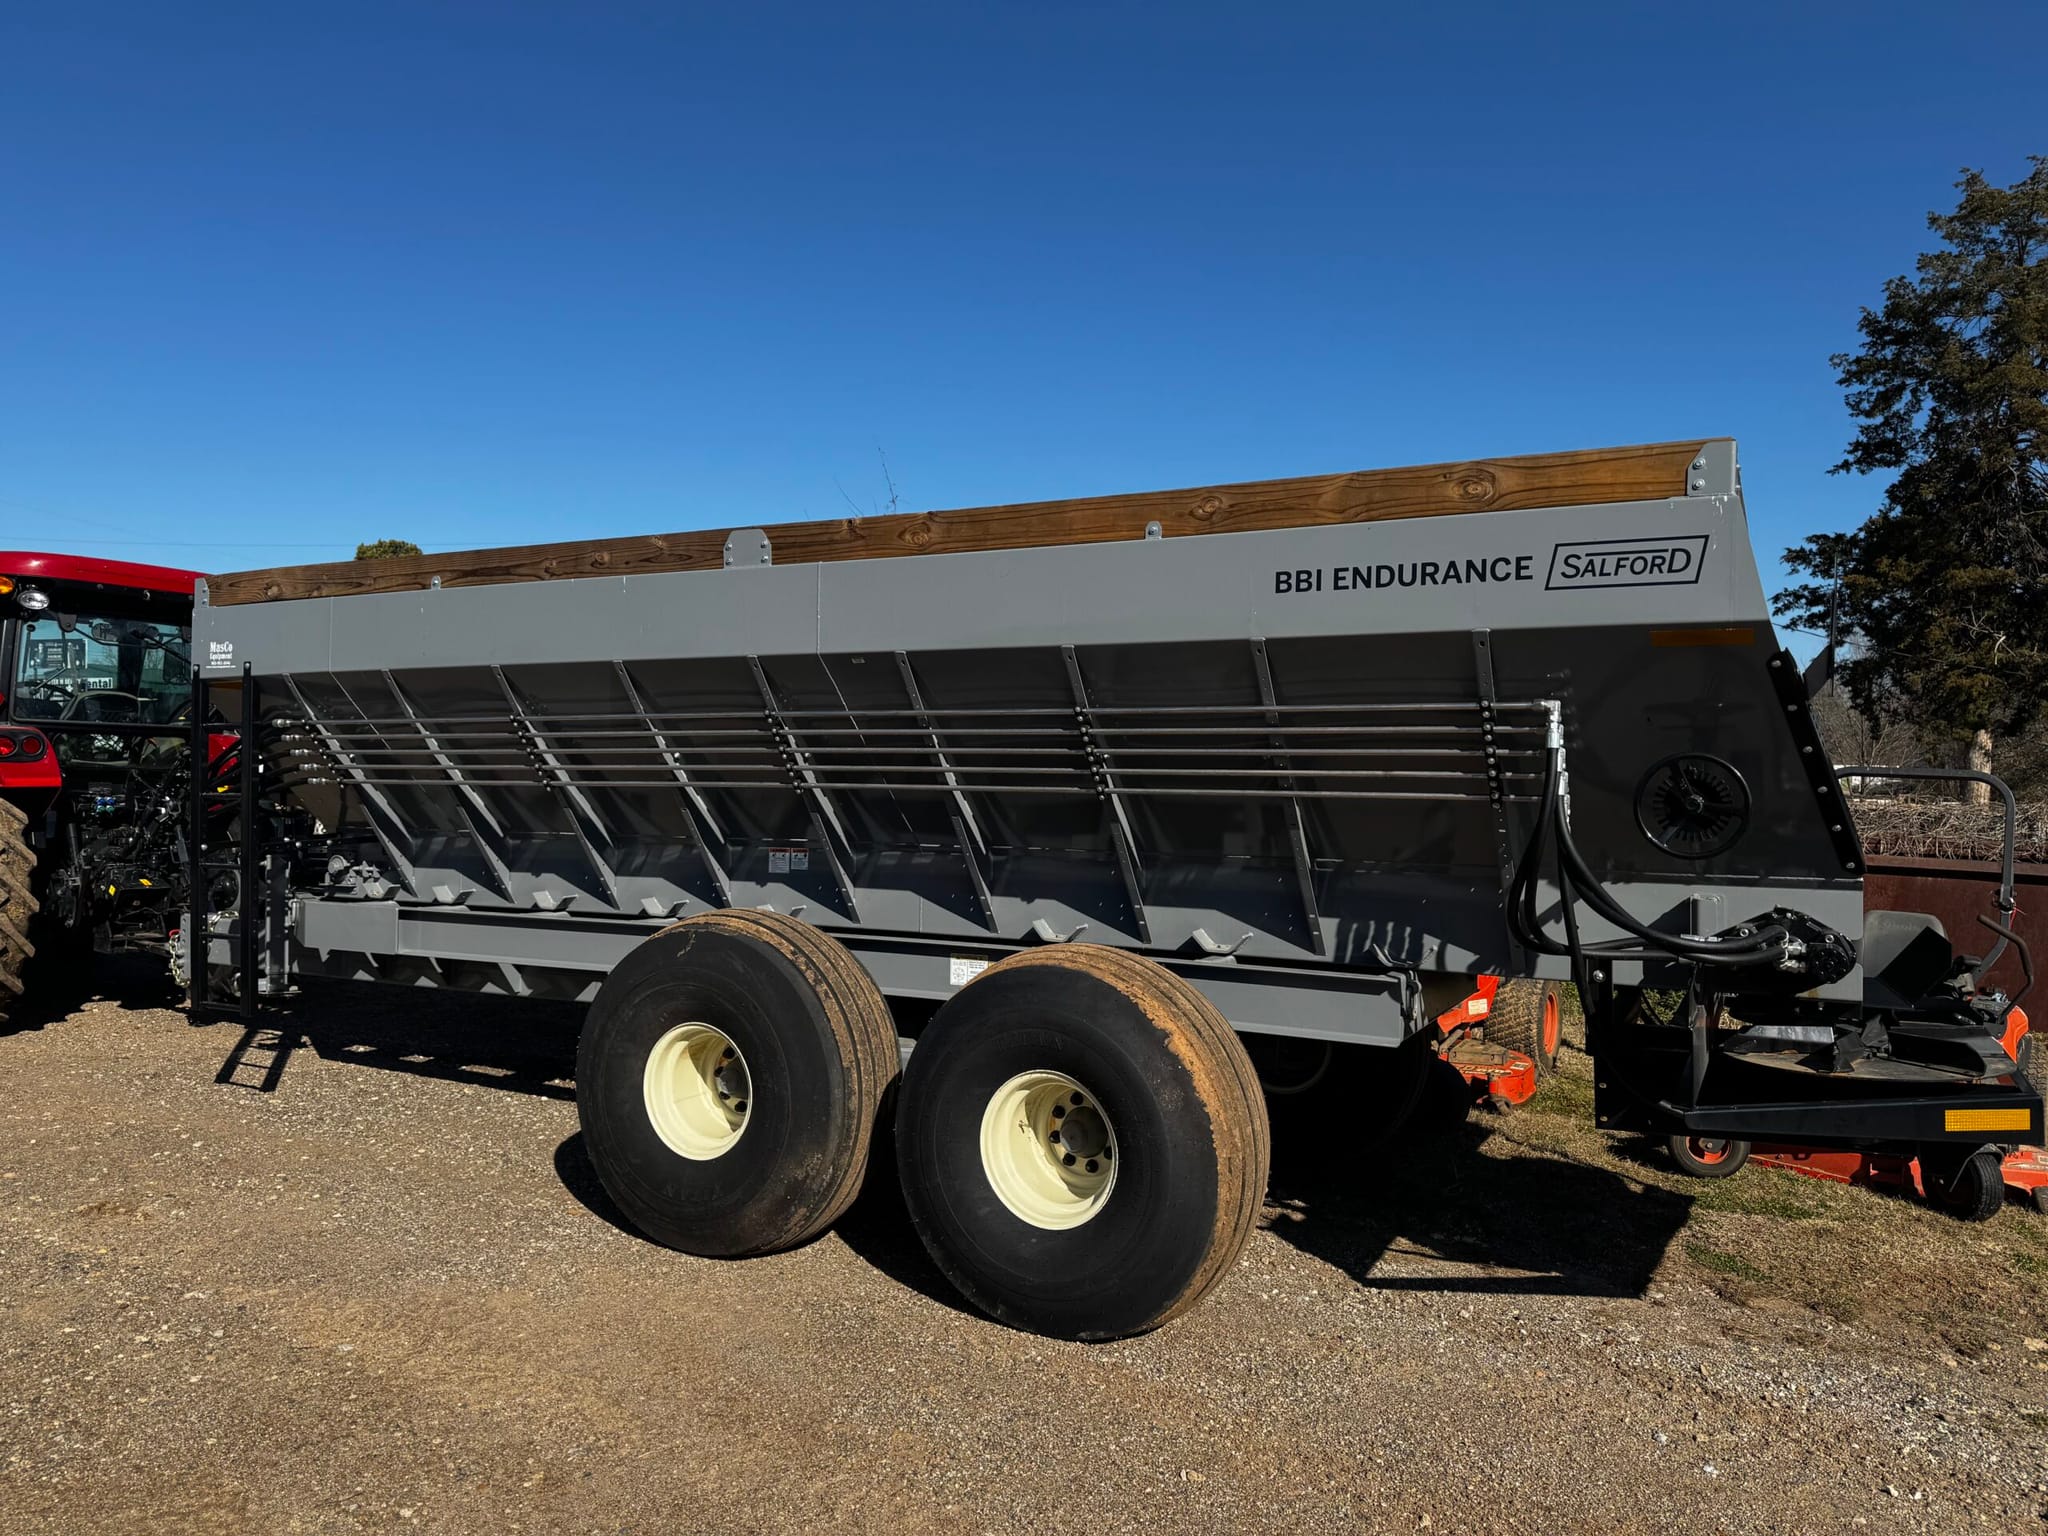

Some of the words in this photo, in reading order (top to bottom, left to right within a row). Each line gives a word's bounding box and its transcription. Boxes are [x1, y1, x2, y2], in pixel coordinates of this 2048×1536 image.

[1560, 547, 1692, 579] SALFORD
[1274, 568, 1322, 594] BBI
[1333, 555, 1534, 591] ENDURANCE
[209, 641, 233, 652] MasCo
[85, 679, 112, 689] ental
